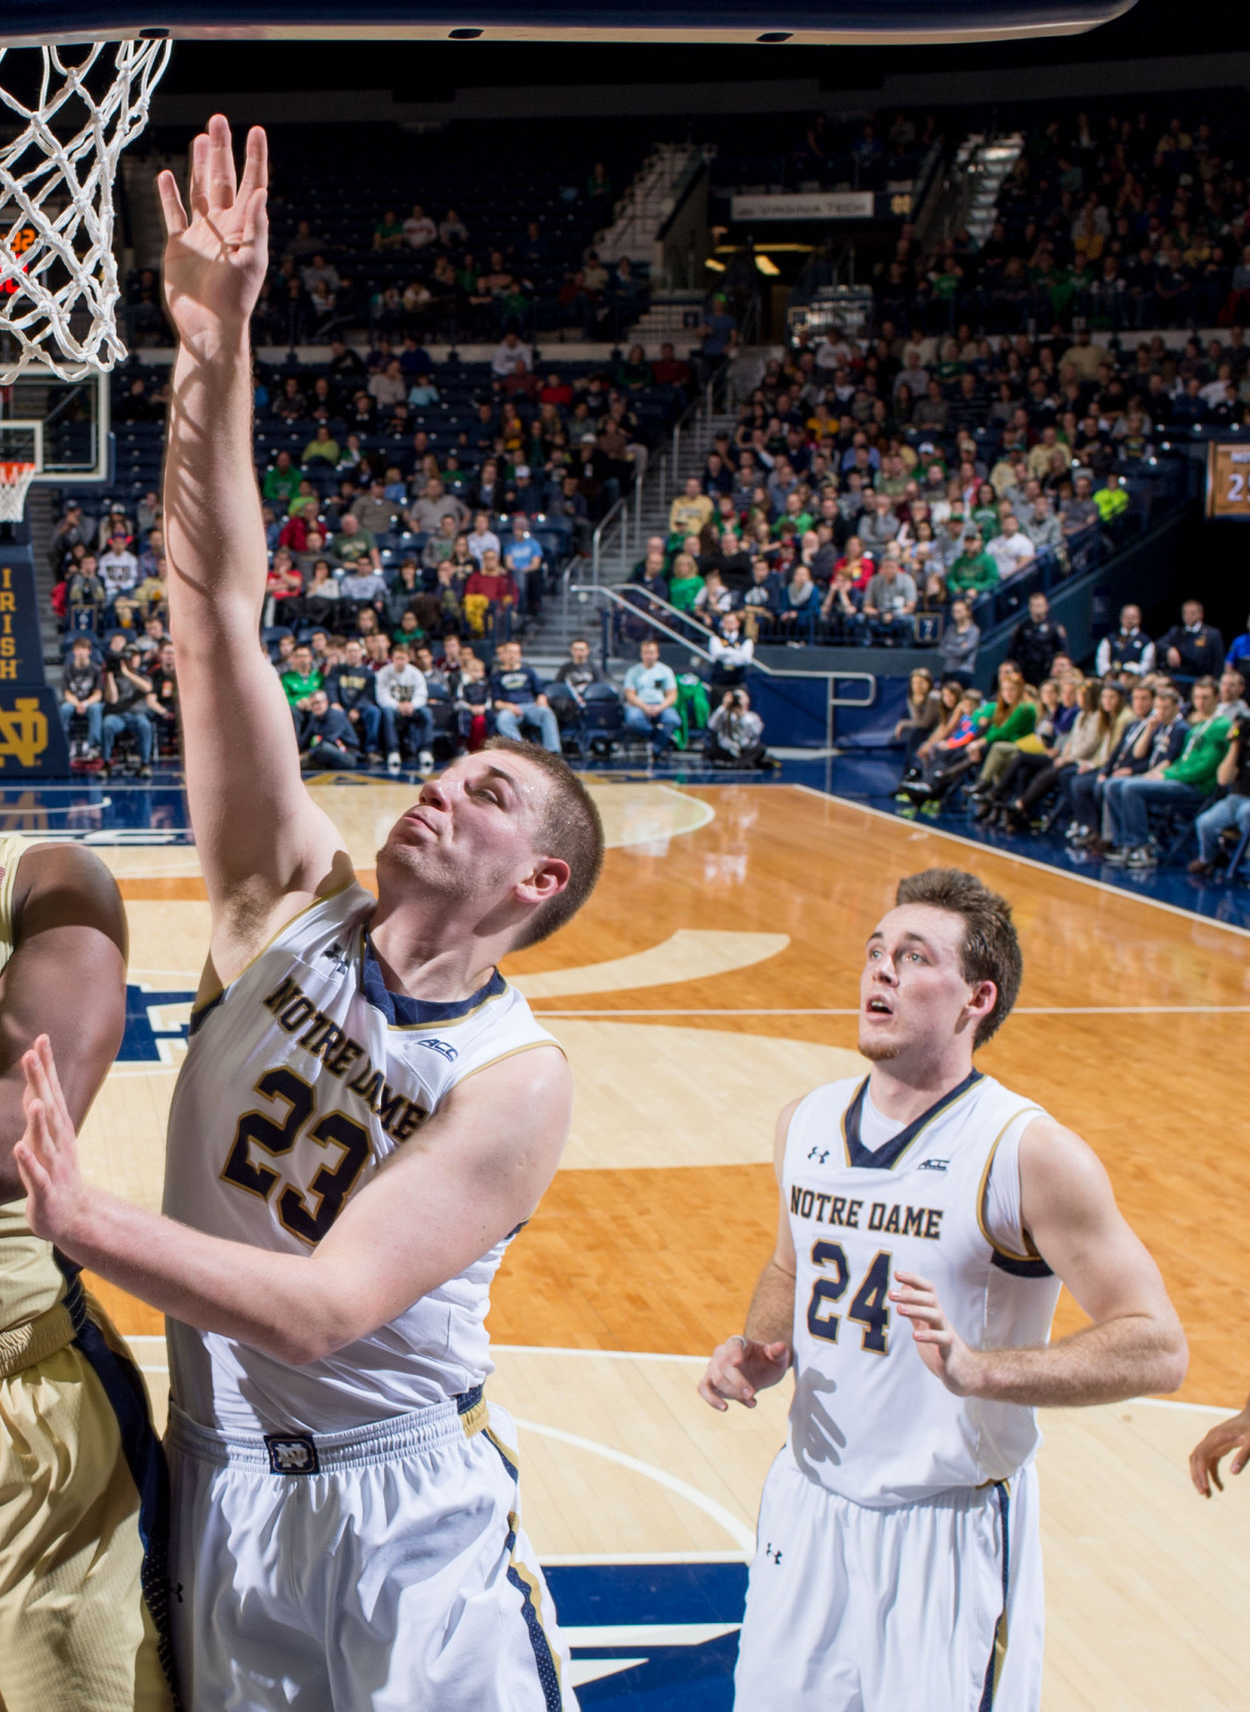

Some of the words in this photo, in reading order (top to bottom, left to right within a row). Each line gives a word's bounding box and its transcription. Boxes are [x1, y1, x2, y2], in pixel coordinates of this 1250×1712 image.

[262, 976, 362, 1080] NOTRE
[219, 1064, 374, 1248] 23
[789, 1184, 865, 1230] NOTRE
[866, 1201, 944, 1241] DAME
[806, 1238, 893, 1357] 24
